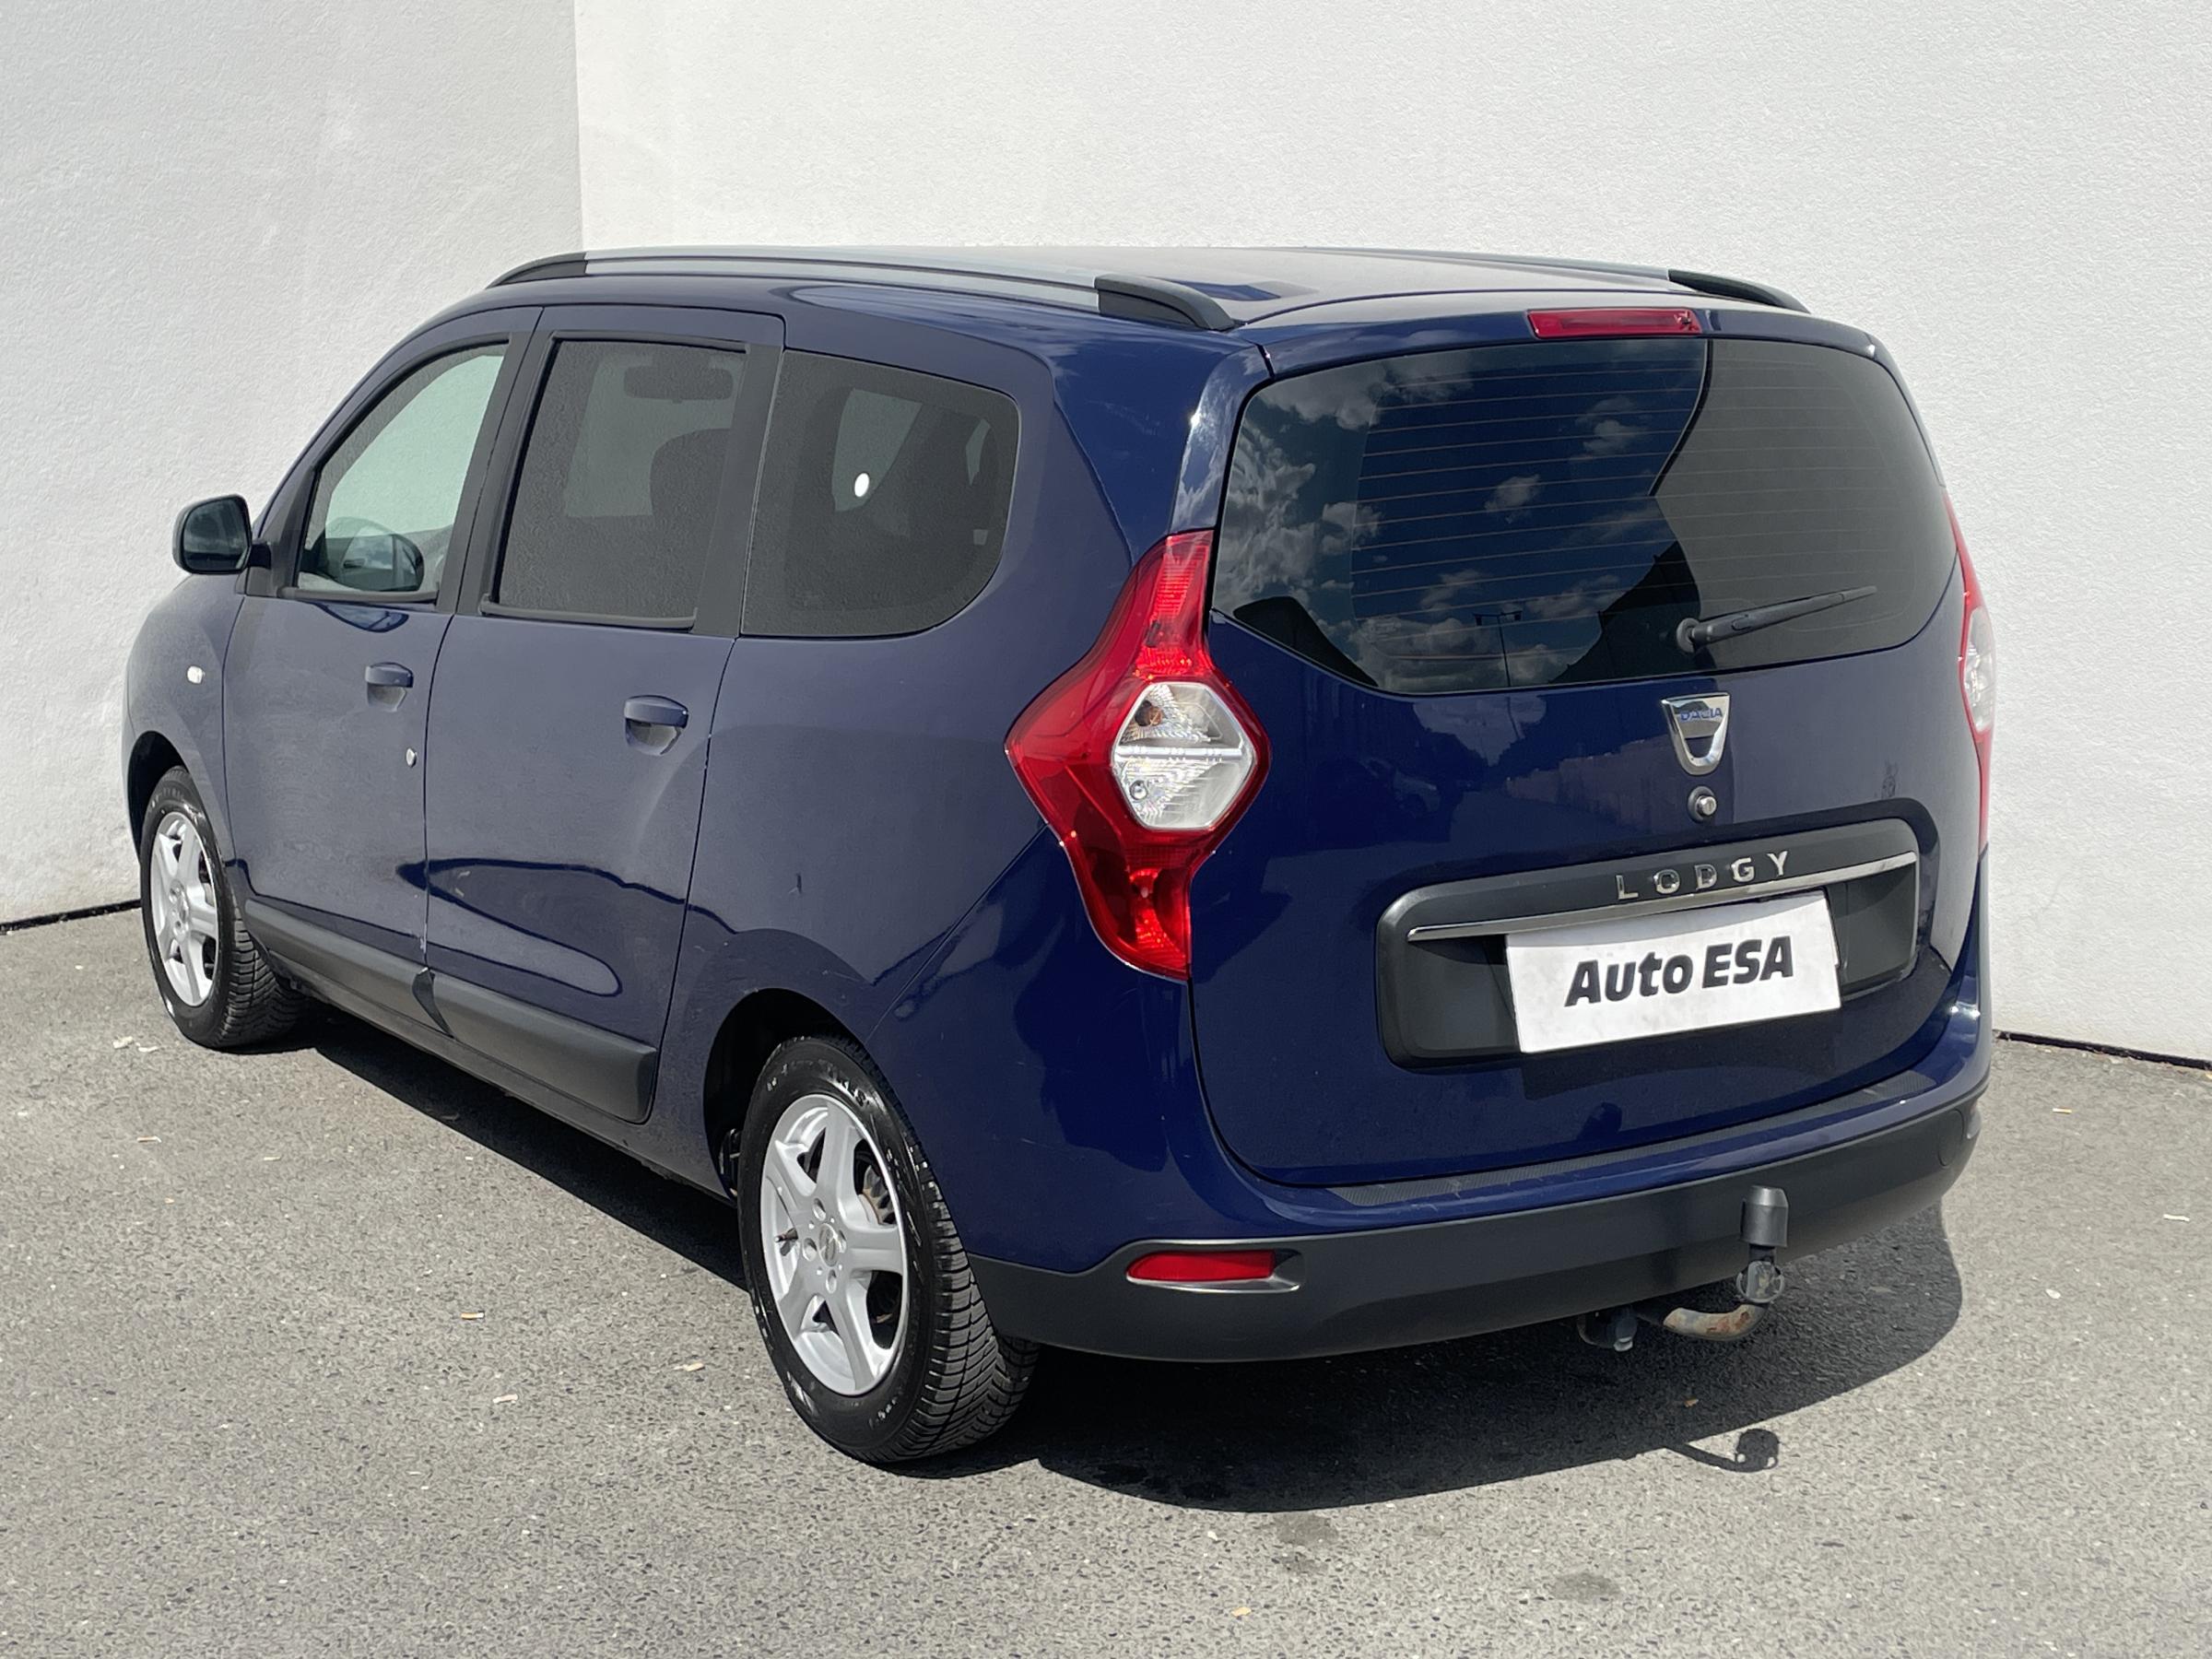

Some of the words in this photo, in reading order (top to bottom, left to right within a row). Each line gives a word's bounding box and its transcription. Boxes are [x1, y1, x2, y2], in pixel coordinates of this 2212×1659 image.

[1679, 707, 1723, 722] DACIA
[1615, 851, 1789, 900] LODGY
[1564, 952, 1694, 1007] Auto
[1701, 935, 1794, 989] ESA
